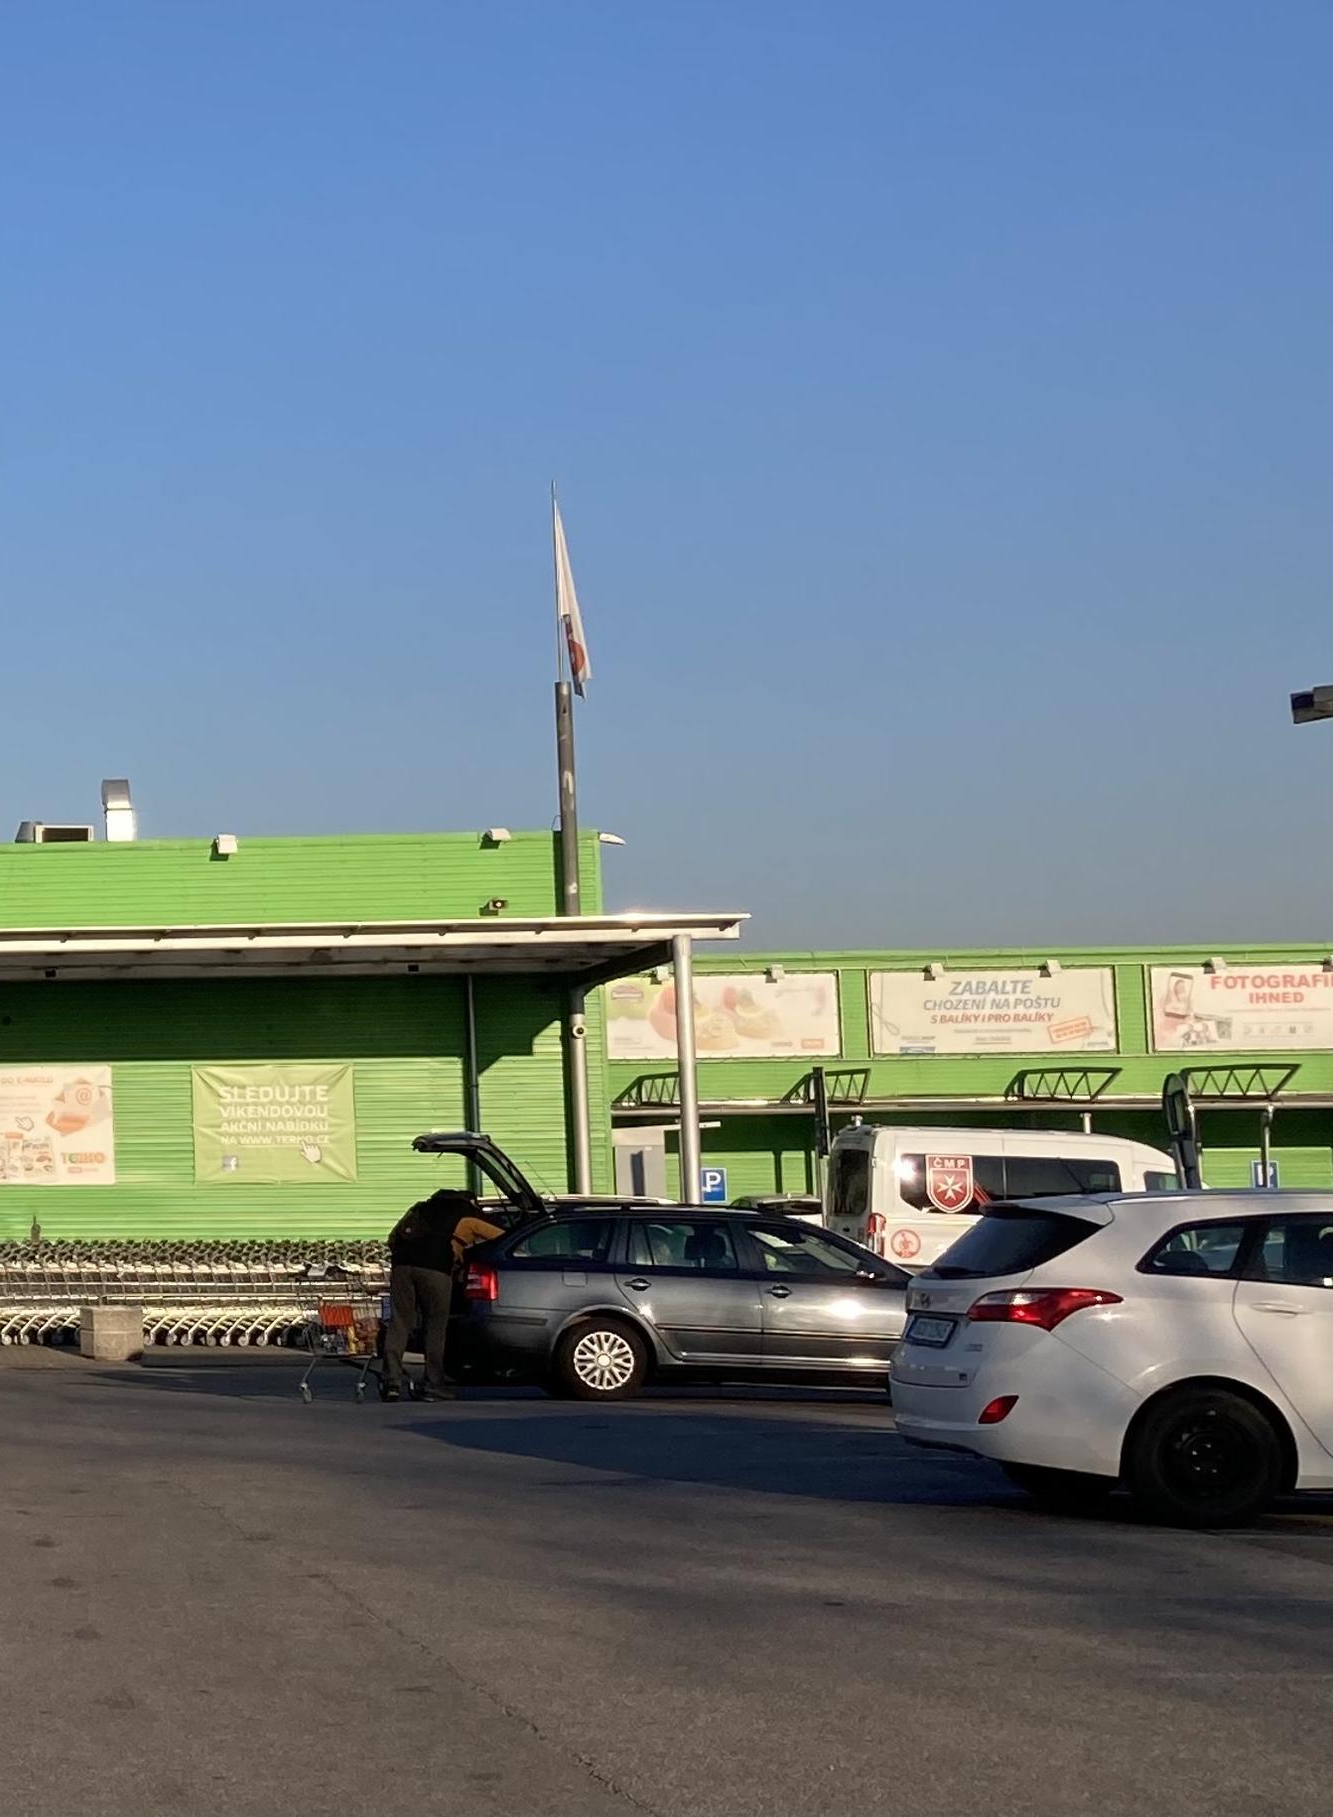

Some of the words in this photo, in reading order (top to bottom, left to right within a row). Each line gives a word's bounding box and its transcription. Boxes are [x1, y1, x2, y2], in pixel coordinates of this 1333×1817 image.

[949, 980, 1033, 996] ZABALTE
[1211, 974, 1333, 989] FOTOGRAFI
[923, 997, 989, 1011] CHOZENÍ
[990, 998, 1010, 1010] NA
[1013, 996, 1061, 1009] POŠTU
[1249, 992, 1304, 1004] IHNED
[939, 1012, 981, 1024] BALÍKY
[987, 1013, 1011, 1023] PRO
[1013, 1010, 1054, 1022] BALÍKY
[221, 1086, 329, 1102] SLEDUJTE
[933, 1156, 965, 1168] ČMP
[705, 1171, 721, 1192] P
